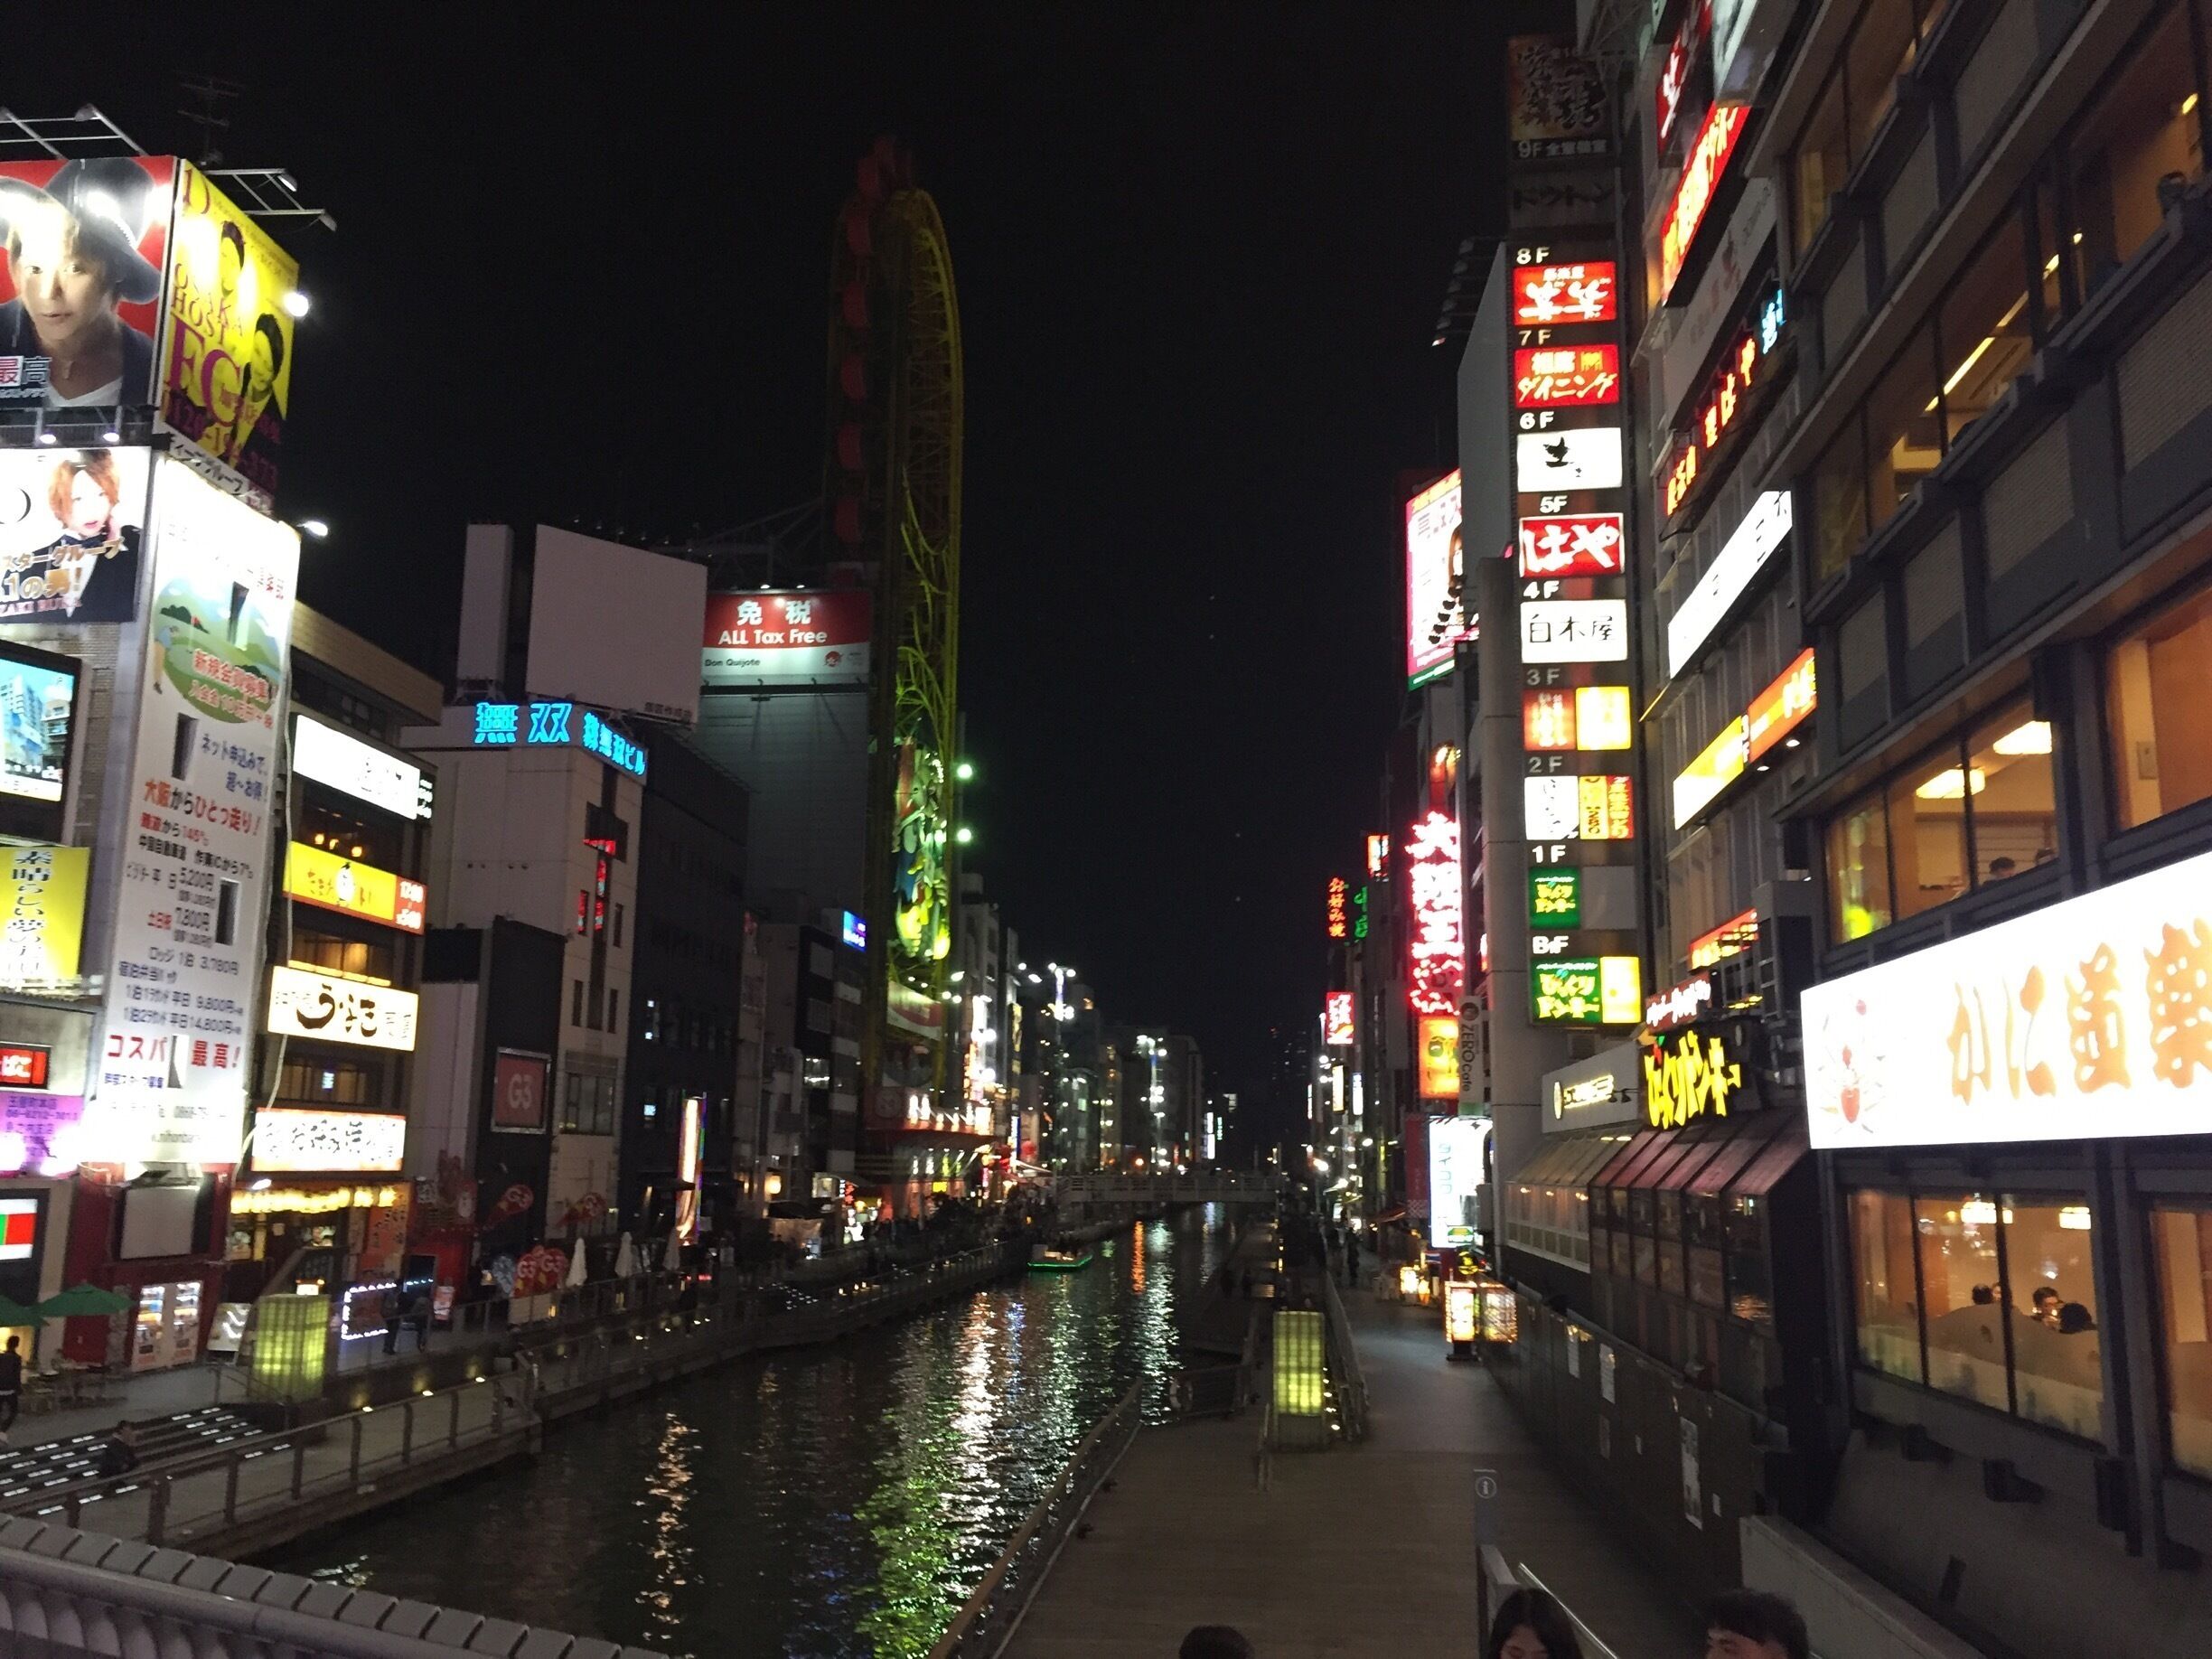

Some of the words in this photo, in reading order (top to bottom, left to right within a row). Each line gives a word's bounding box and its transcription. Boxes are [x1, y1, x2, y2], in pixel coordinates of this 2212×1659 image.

[1516, 248, 1550, 264] 8F
[1518, 330, 1551, 345] 7F
[1518, 372, 1617, 403] ダイニング
[1519, 412, 1554, 429] 6F
[1540, 495, 1568, 513] 5F
[1523, 580, 1560, 598] 4F
[737, 600, 811, 625] 免税
[718, 631, 749, 644] ALL
[755, 630, 784, 644] Tax
[789, 629, 827, 643] Free
[726, 658, 761, 669] Quijote
[1527, 669, 1561, 685] 3F
[474, 702, 572, 744] 無双
[1529, 756, 1563, 773] 2F
[1532, 845, 1566, 863] 1F
[108, 1035, 169, 1063] コスパ
